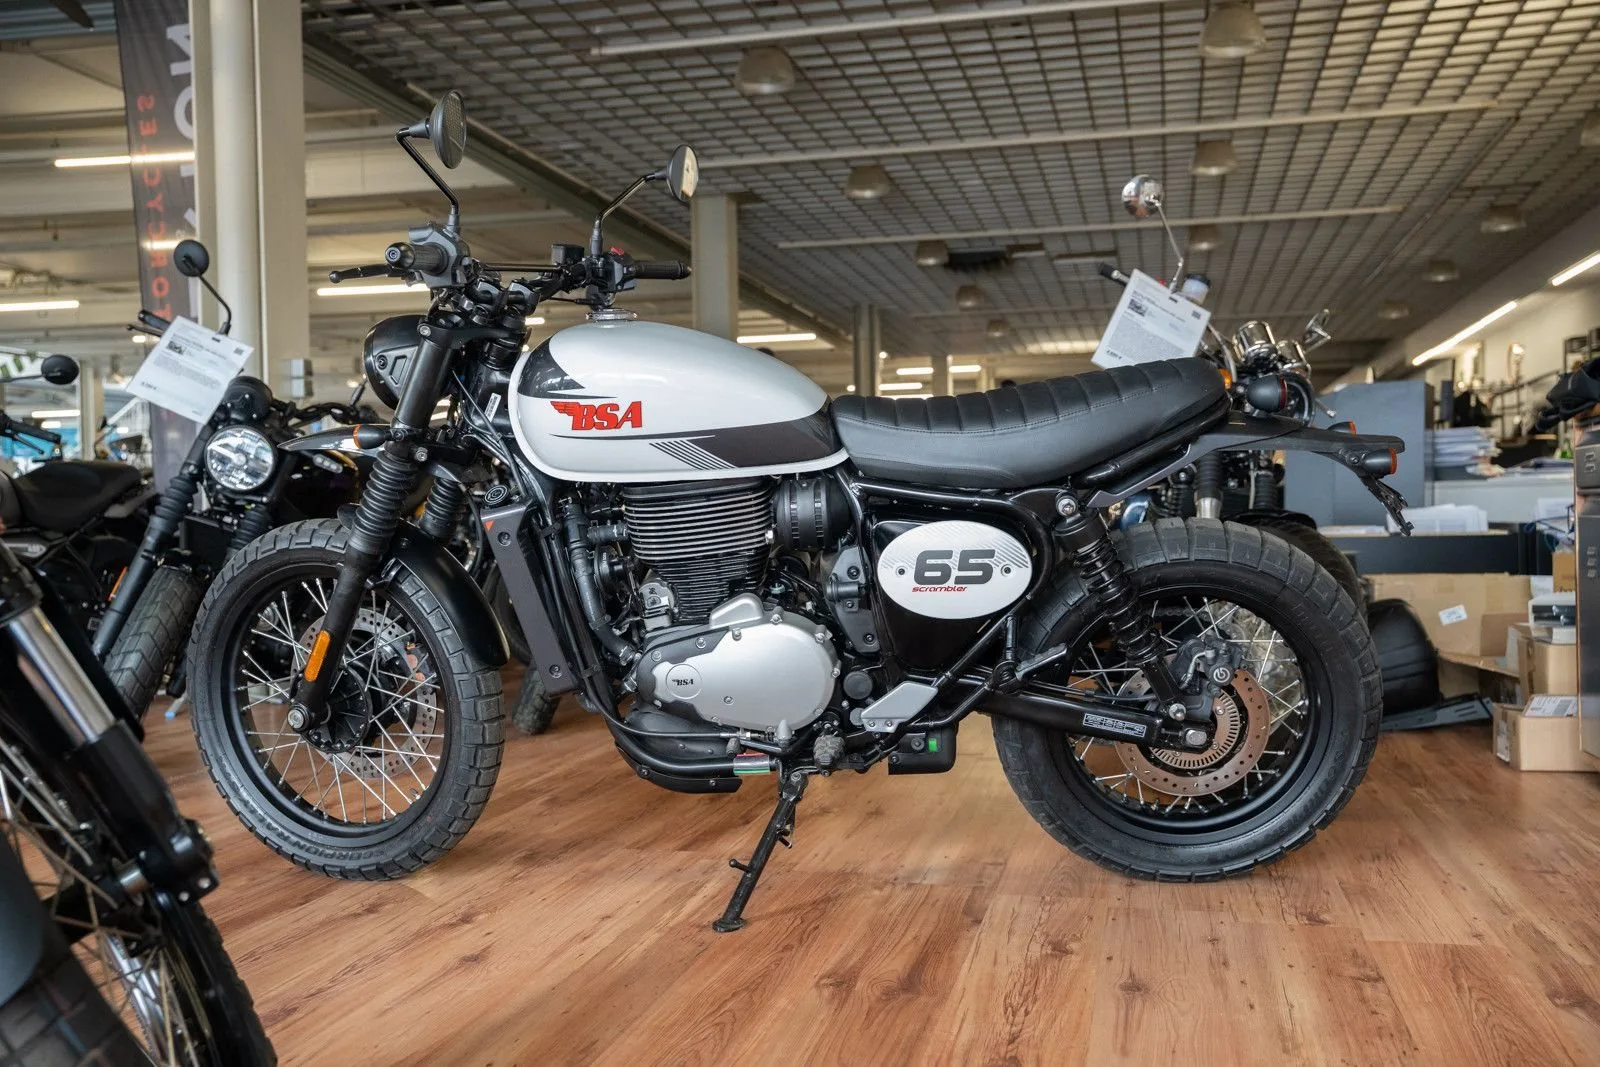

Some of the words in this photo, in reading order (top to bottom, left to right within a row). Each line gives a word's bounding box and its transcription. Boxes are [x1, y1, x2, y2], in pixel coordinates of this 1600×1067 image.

[568, 400, 643, 431] BSA
[913, 549, 996, 585] 65
[911, 585, 968, 593] scrambler
[675, 678, 695, 686] BSA
